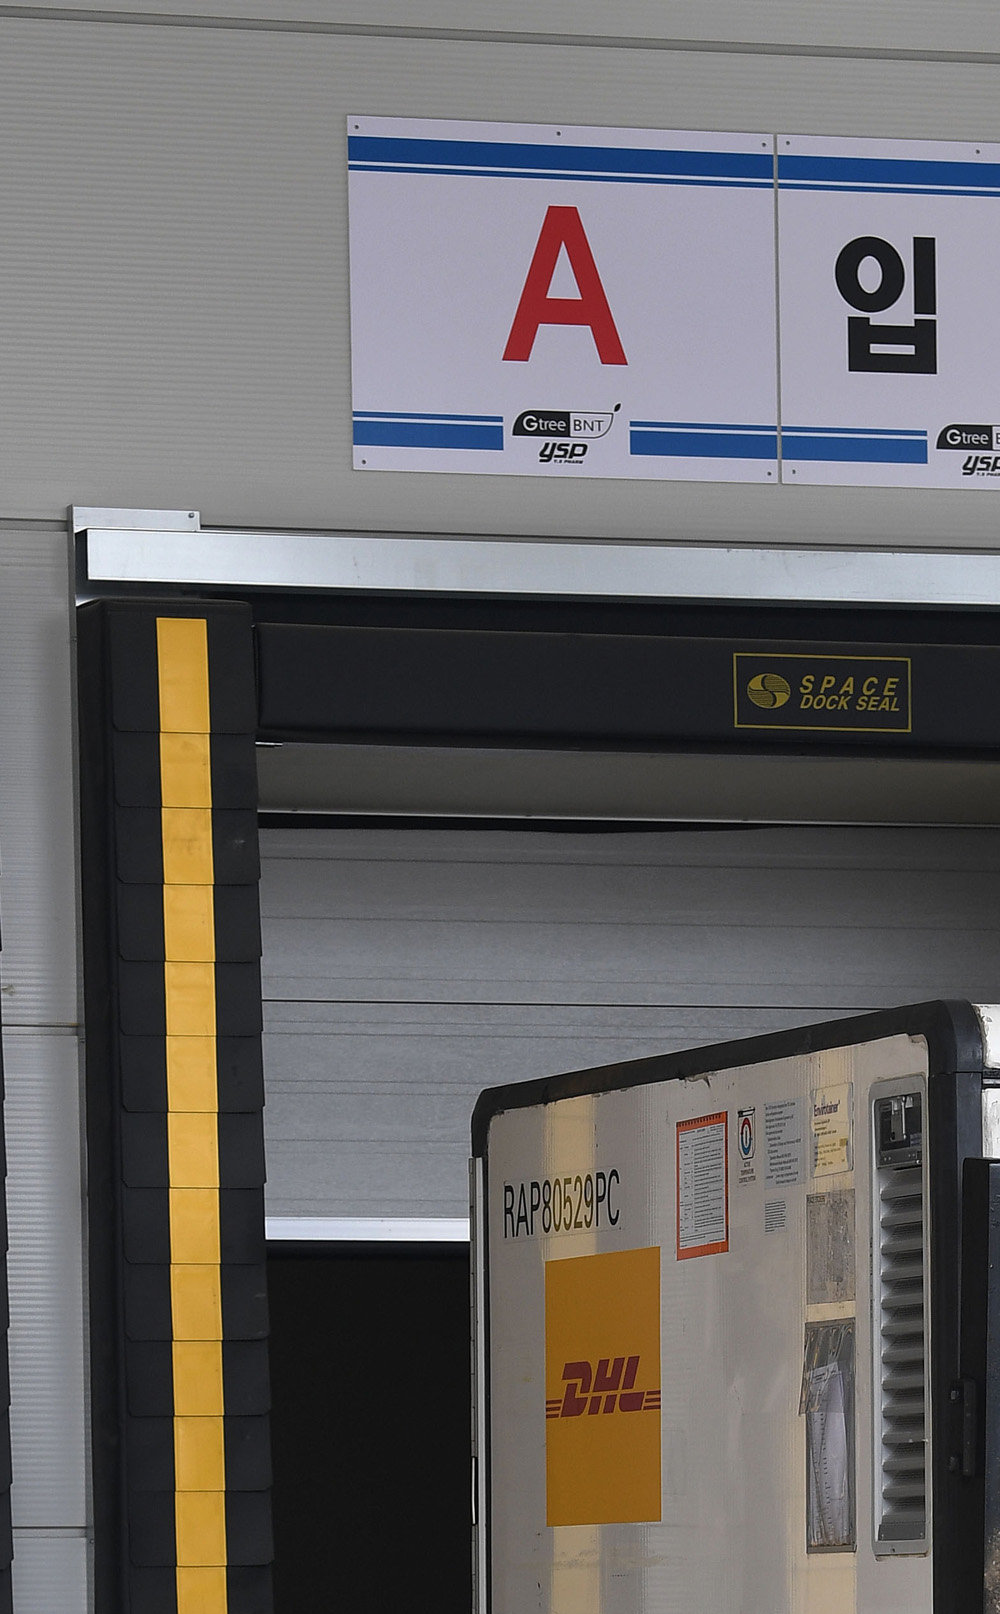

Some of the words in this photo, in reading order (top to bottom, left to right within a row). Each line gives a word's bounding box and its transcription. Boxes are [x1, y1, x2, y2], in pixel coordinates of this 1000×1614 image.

[502, 205, 629, 365] A
[573, 419, 604, 432] BNT
[799, 675, 900, 696] SPACE
[800, 694, 851, 710] DOCK
[856, 696, 900, 712] SEAL
[503, 1168, 620, 1239] RAP80529PC
[561, 1355, 645, 1418] DHL
